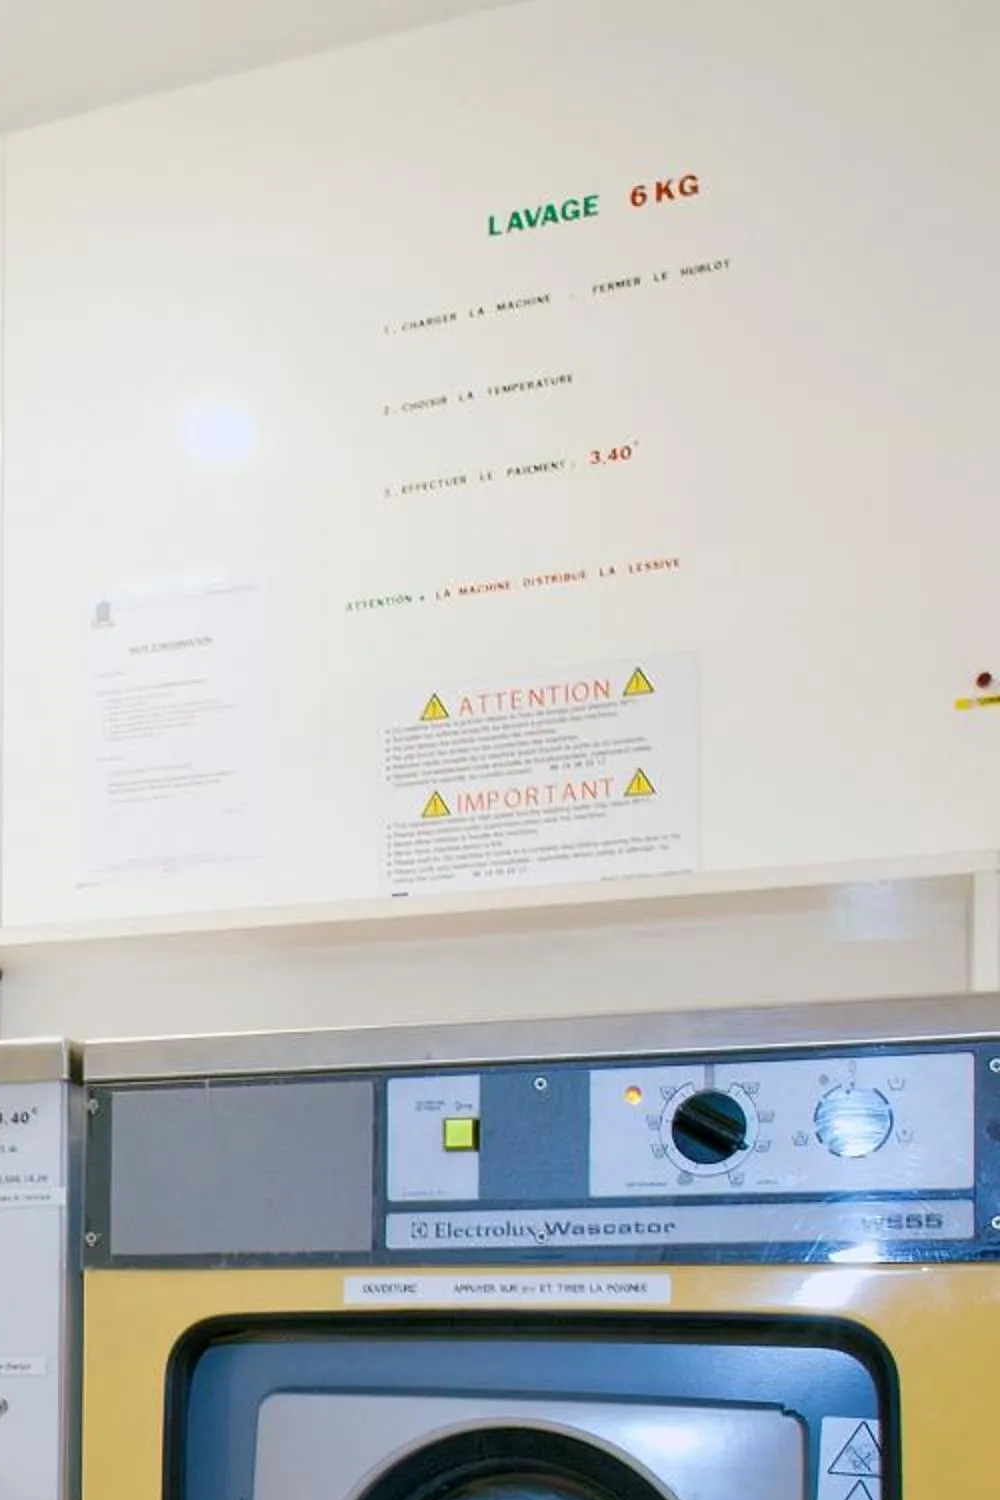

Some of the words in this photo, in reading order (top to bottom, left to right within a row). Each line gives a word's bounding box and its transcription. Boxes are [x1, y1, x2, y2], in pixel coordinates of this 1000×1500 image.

[487, 193, 600, 236] LAVAGE
[469, 305, 485, 319] LA
[496, 293, 552, 313] MACHINE
[591, 275, 642, 296] FERMER
[653, 271, 669, 283] LE
[680, 258, 731, 277] HUBLOT
[458, 390, 474, 403] LA
[487, 372, 574, 397] TEMPERATURE
[479, 470, 494, 483] LE
[435, 589, 452, 602] LA
[599, 567, 616, 579] LA
[628, 557, 682, 575] LESSIVE
[458, 678, 613, 717] ATTENTION
[457, 777, 615, 814] IMPORTANT
[434, 1220, 538, 1241] Electrolux
[544, 1219, 677, 1237] Wascator
[540, 1280, 552, 1293] ET
[589, 1280, 604, 1293] LA
